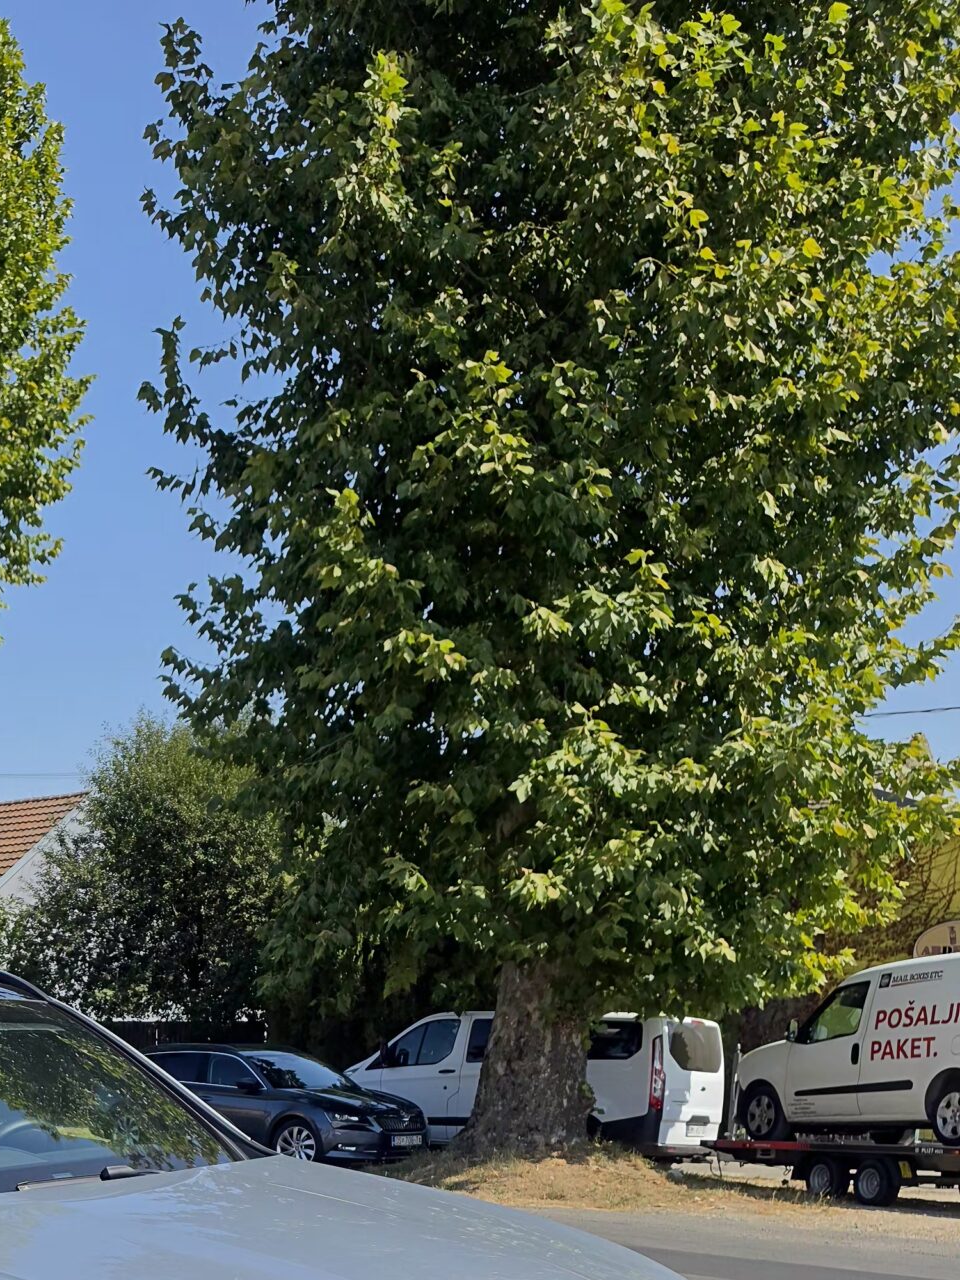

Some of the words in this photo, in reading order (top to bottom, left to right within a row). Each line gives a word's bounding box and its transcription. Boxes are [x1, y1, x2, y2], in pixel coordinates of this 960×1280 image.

[891, 974, 909, 984] MAIL
[874, 1000, 960, 1031] POŠALJI
[870, 1036, 938, 1061] PAKET.
